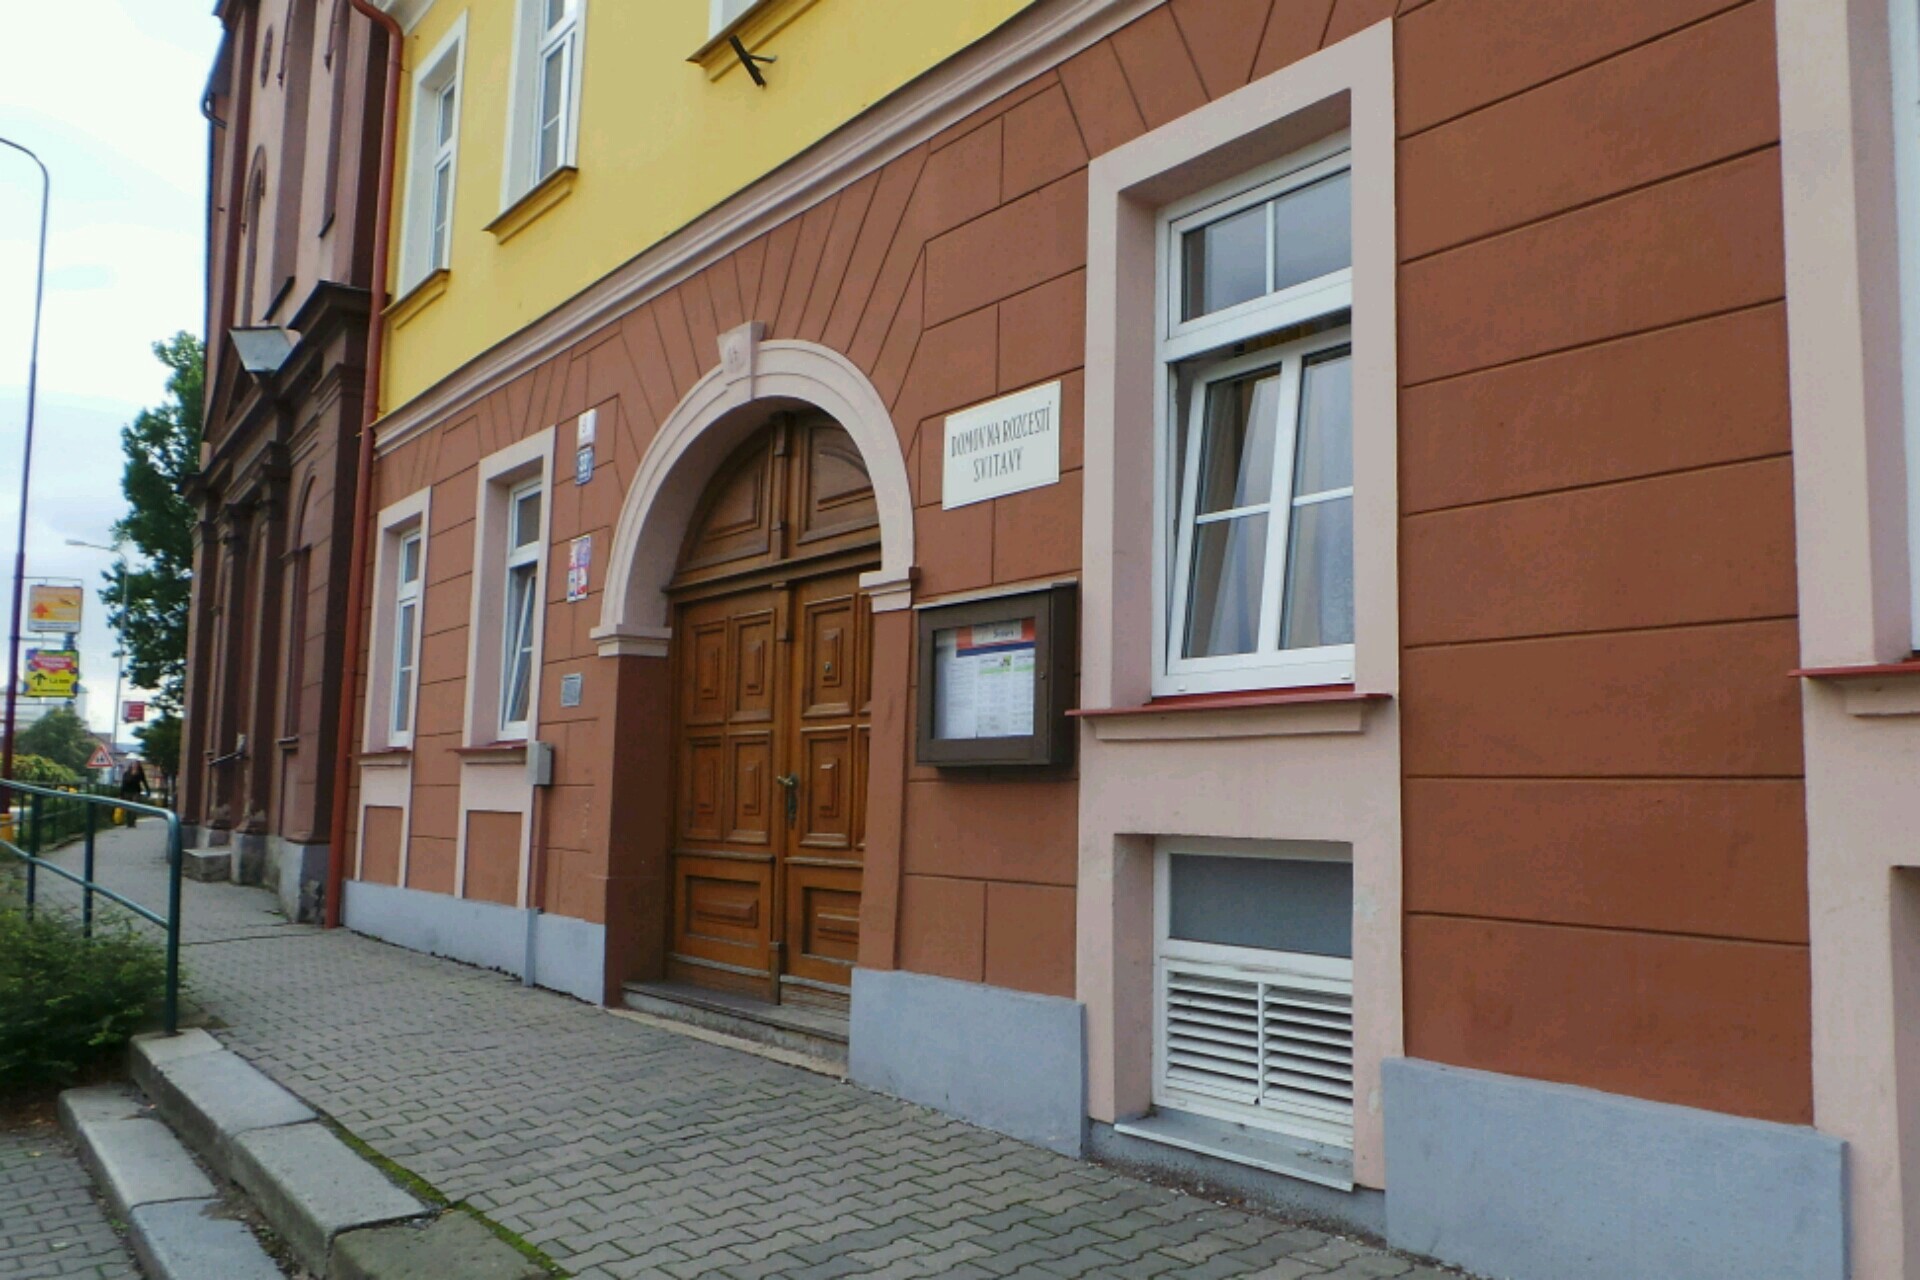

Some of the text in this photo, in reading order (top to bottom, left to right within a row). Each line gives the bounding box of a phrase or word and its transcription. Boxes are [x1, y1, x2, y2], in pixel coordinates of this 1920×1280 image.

[951, 425, 986, 457] DOMOV
[987, 422, 1001, 447] NA
[973, 446, 1024, 483] SVITAVY
